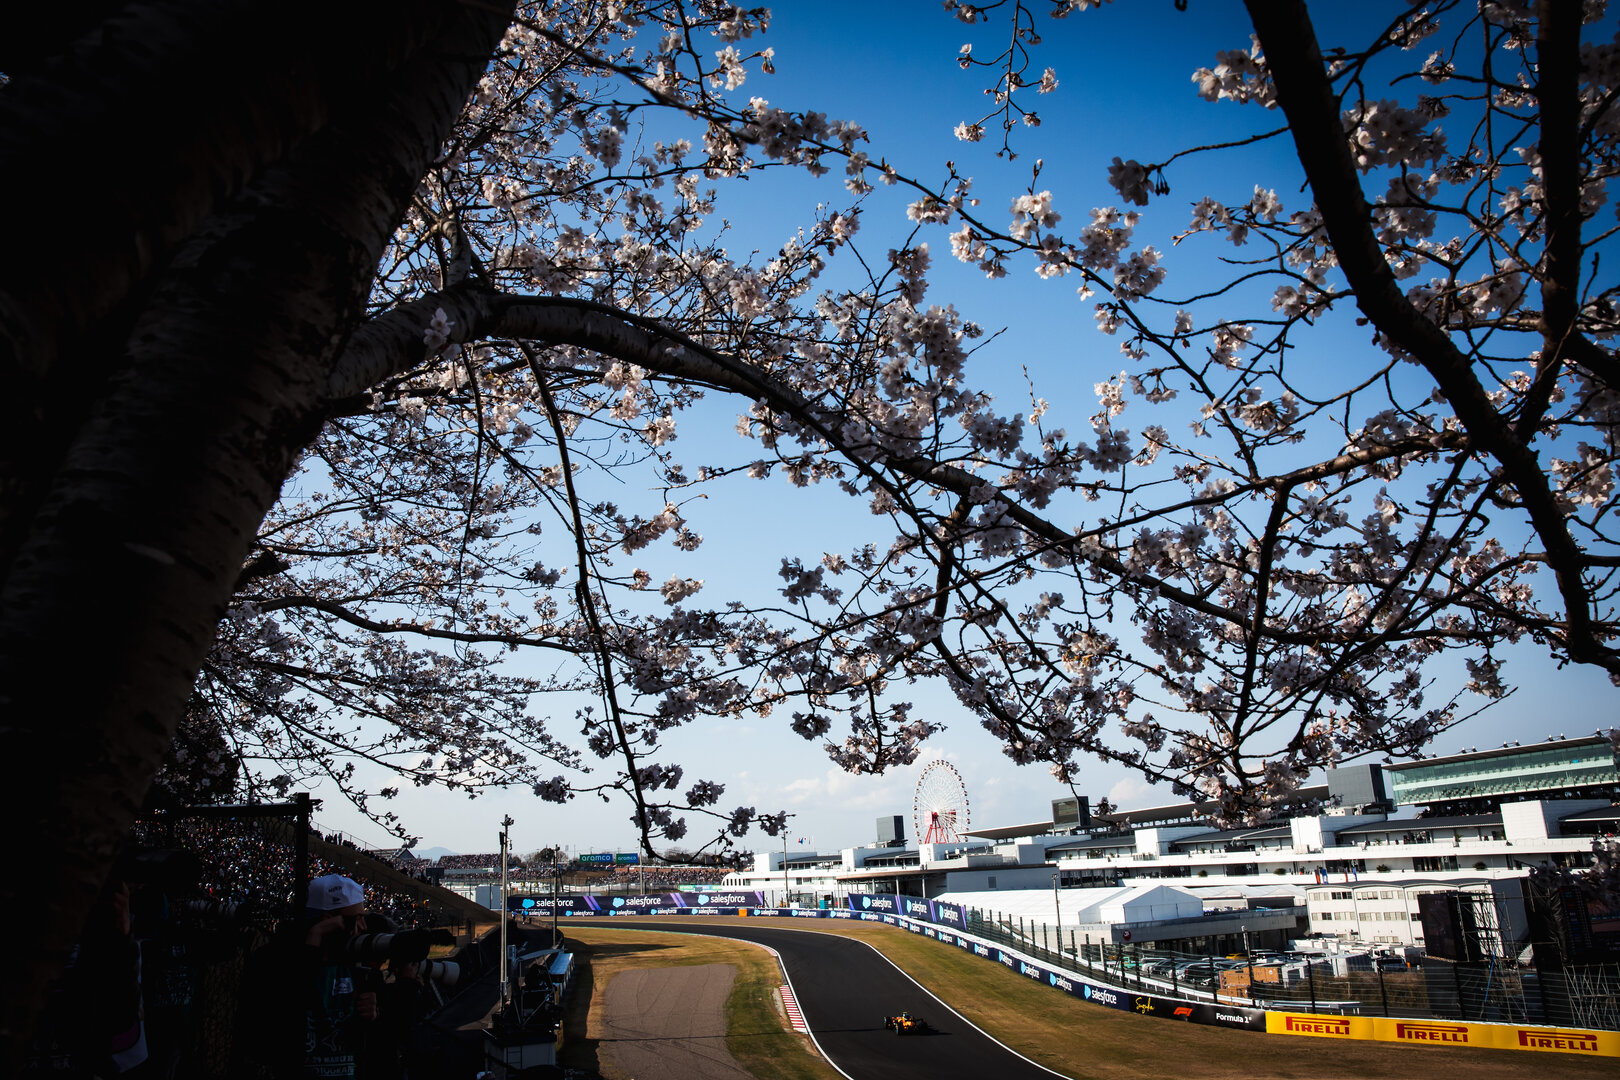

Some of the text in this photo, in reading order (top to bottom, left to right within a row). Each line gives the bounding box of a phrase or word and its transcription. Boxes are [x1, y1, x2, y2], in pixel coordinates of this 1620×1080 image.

[626, 896, 661, 907] salesforce
[711, 895, 746, 905] salesforce
[1091, 988, 1117, 1005] salesforce
[1216, 1013, 1244, 1023] Formula
[1286, 1016, 1350, 1035] PIRELLI
[1396, 1023, 1468, 1043] PIRELLI
[1518, 1030, 1598, 1051] PIRELLI
